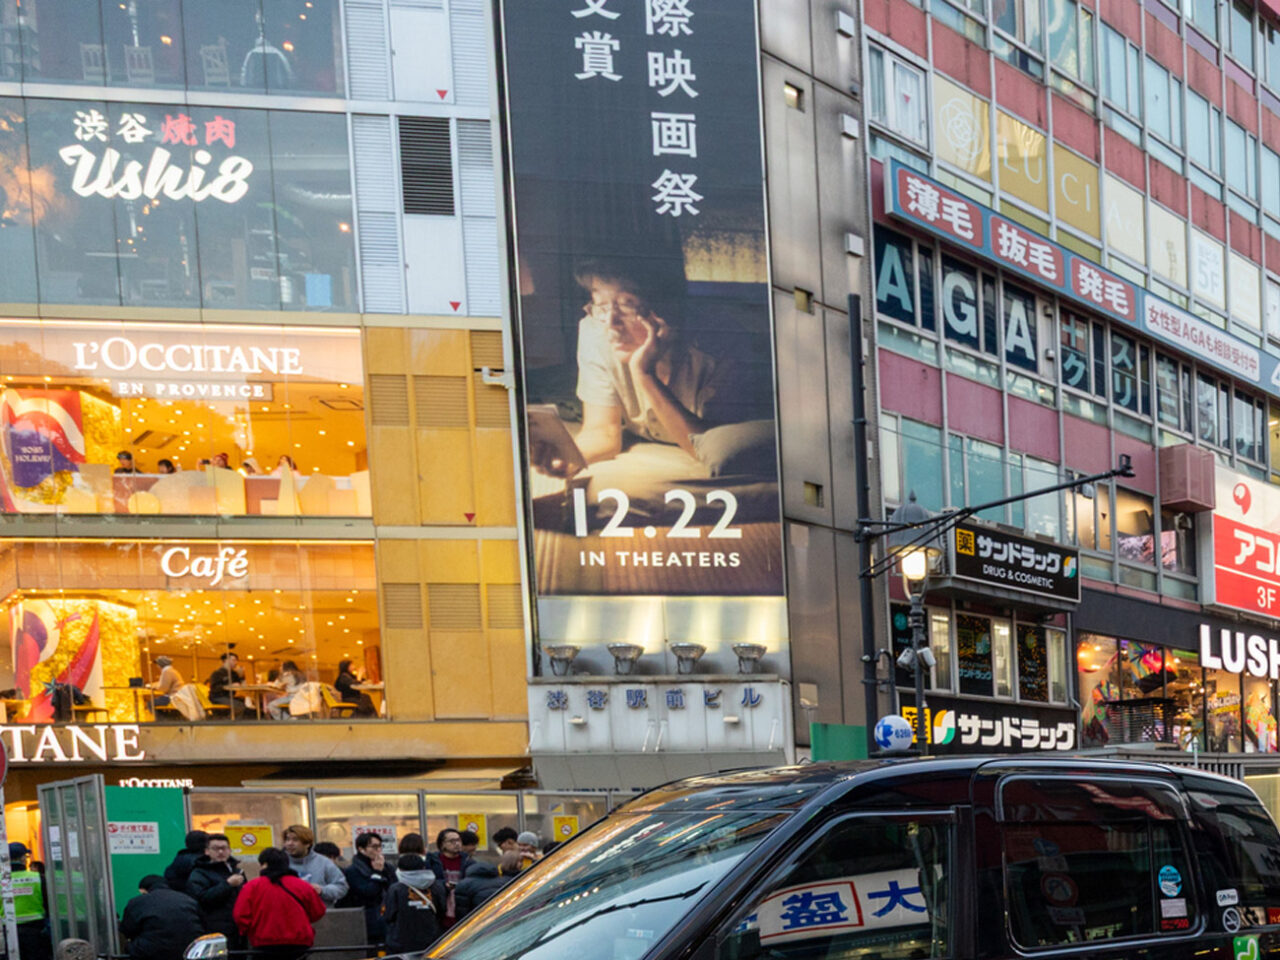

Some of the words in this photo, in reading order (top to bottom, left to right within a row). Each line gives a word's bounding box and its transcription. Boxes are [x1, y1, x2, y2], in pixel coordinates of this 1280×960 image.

[58, 144, 254, 203] Ushi8
[905, 176, 974, 242] 薄毛
[997, 222, 1058, 281] 抜毛
[876, 243, 1036, 361] AGA
[1078, 257, 1130, 317] 発毛
[72, 337, 304, 375] L'OCCITANE
[118, 381, 144, 395] EN
[156, 382, 265, 397] PROVENCE
[573, 488, 743, 539] 12.22
[161, 547, 248, 585] Café
[580, 551, 605, 567] IN
[616, 551, 741, 568] THEATERS
[976, 535, 1061, 574] サンドラッグ
[982, 564, 1006, 579] DRUG
[1007, 569, 1015, 580] &
[1014, 571, 1054, 589] COSMETIC
[1256, 586, 1277, 610] 3F
[547, 687, 762, 711] 渋谷駅前ビル
[957, 714, 1076, 751] サンドラッグ
